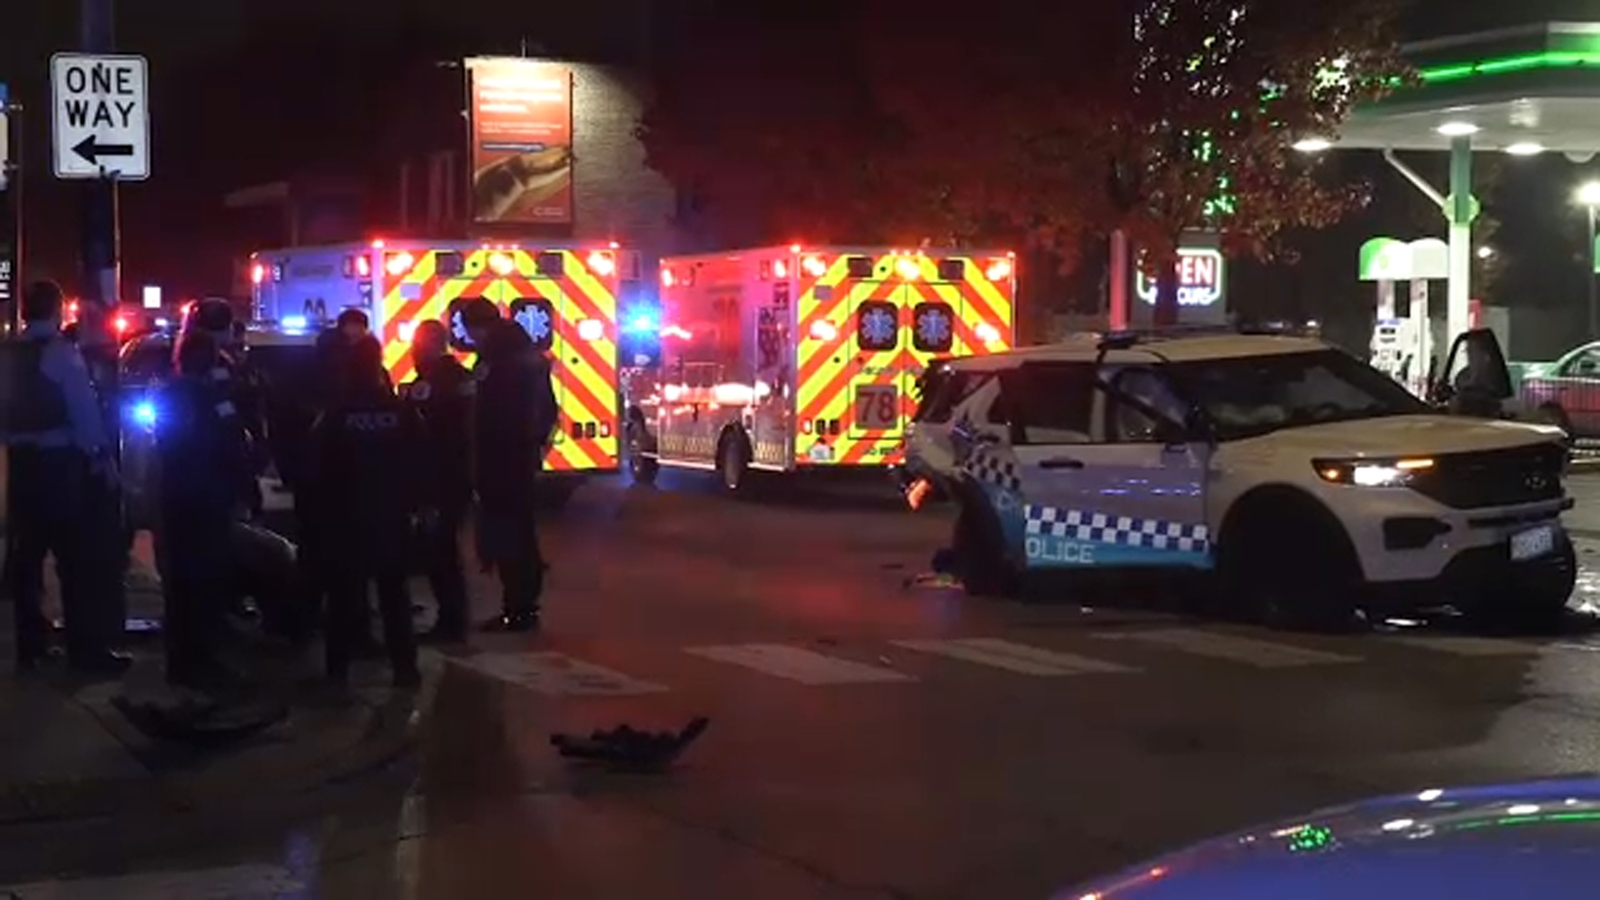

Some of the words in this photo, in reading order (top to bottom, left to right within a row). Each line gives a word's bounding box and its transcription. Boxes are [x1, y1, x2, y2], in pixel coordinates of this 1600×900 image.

[66, 66, 134, 95] ONE
[65, 100, 136, 129] WAY
[859, 391, 895, 424] 78
[1024, 536, 1096, 564] OLICE
